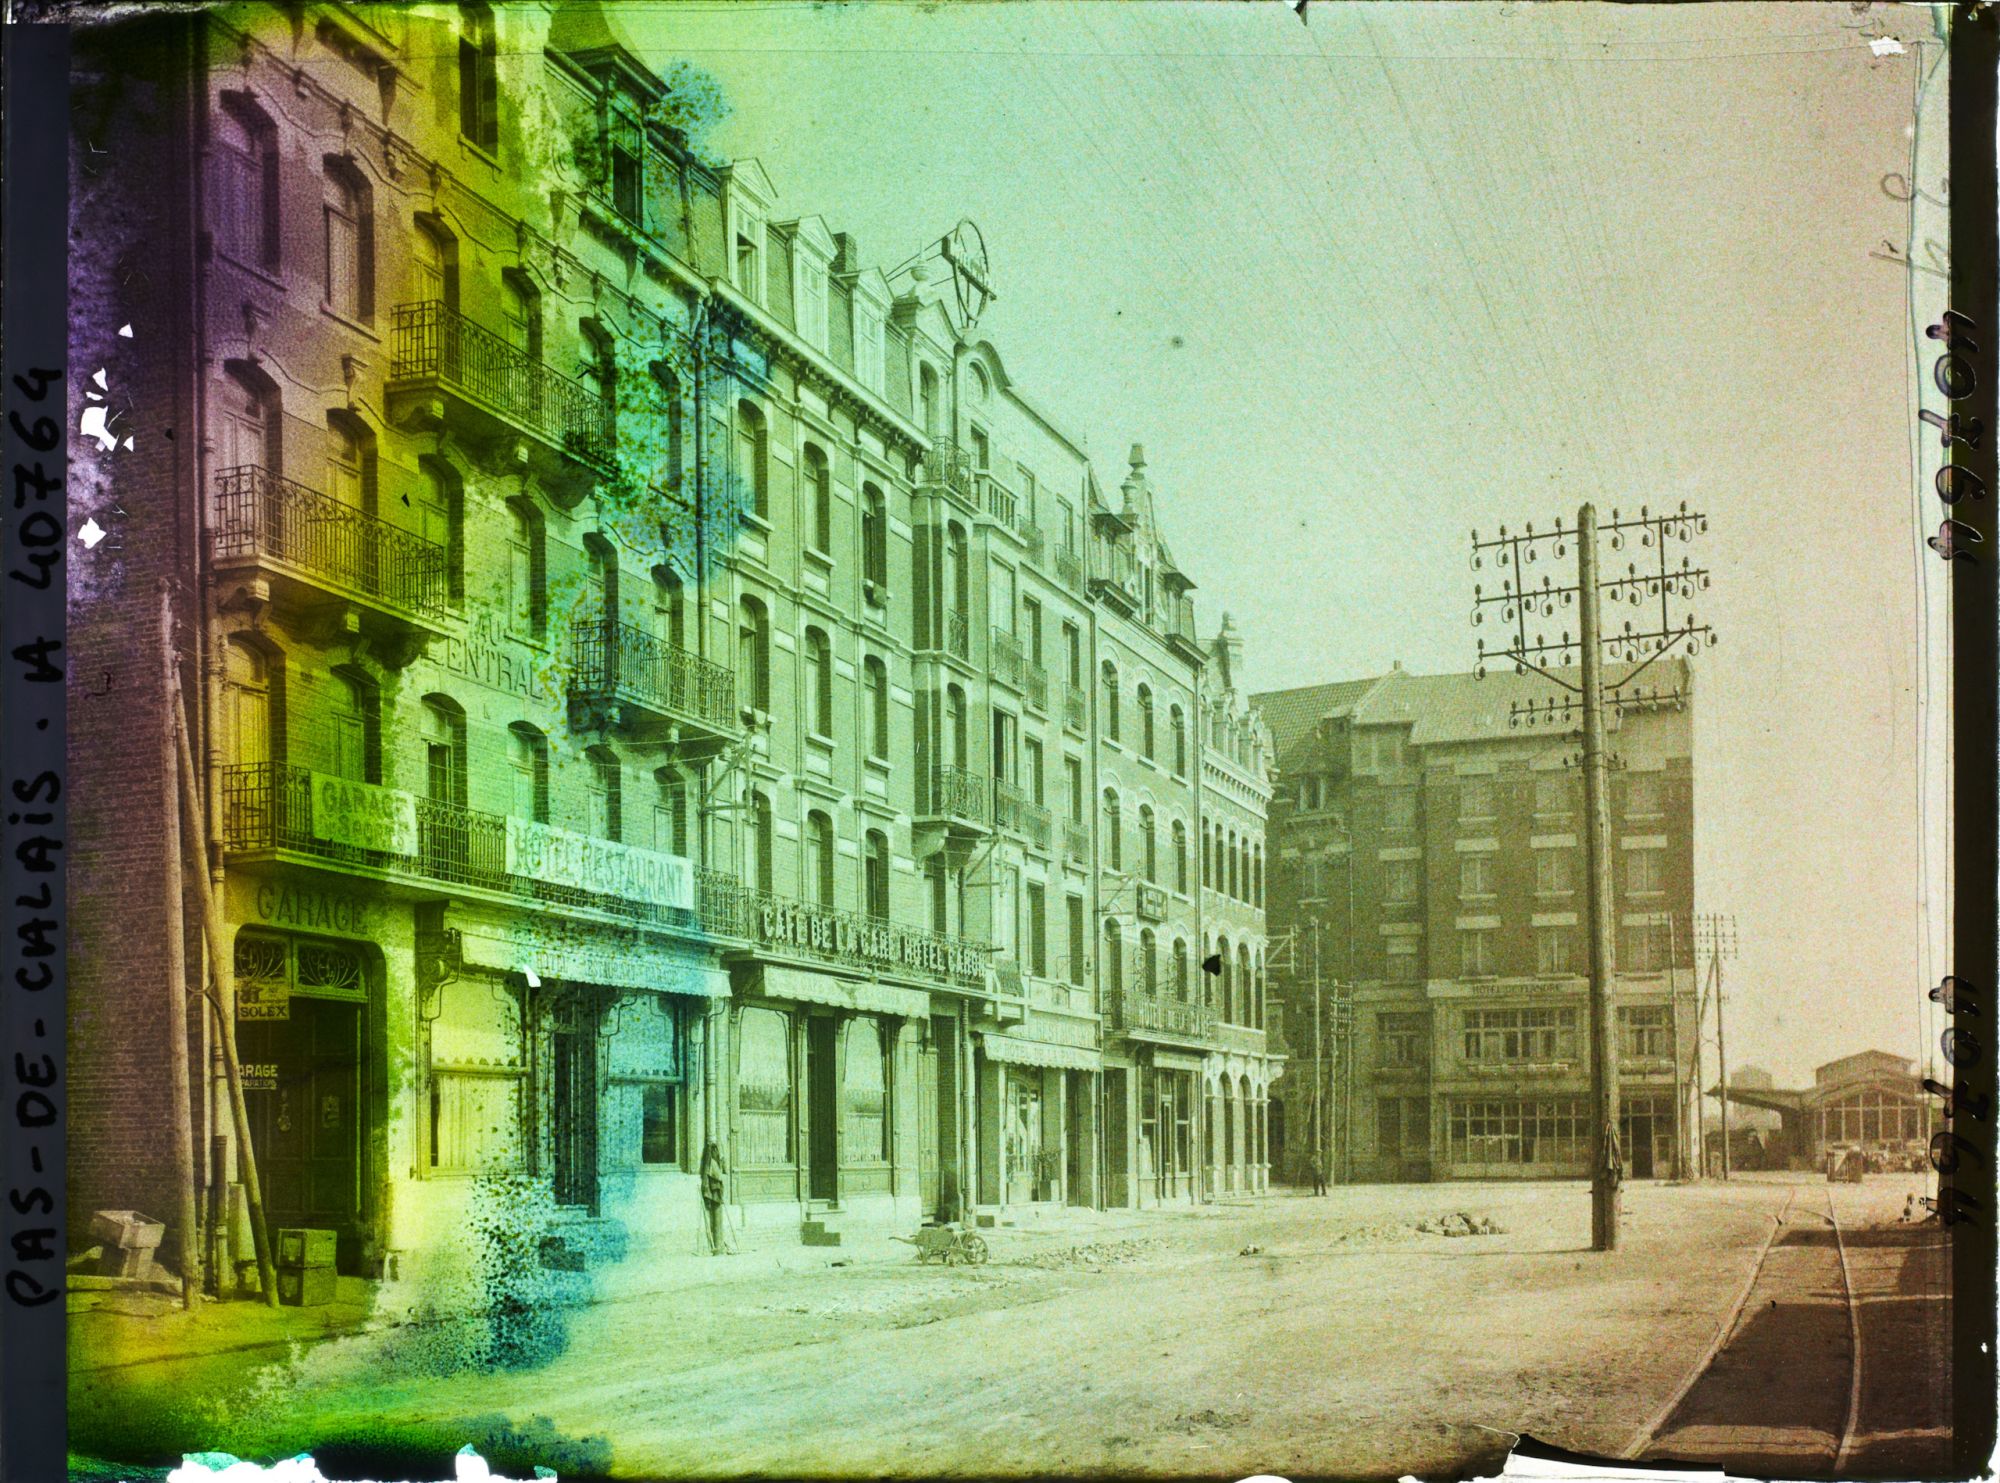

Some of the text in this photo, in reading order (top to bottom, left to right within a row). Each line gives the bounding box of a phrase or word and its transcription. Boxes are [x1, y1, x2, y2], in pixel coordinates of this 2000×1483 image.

[1918, 309, 1984, 567] 40764
[8, 367, 64, 590] 40764
[11, 636, 64, 683] A
[322, 780, 408, 820] GARAGE
[514, 824, 684, 905] HOTEL RESTAURANT
[257, 884, 368, 935] GARAGE
[811, 914, 833, 949] DE
[836, 919, 858, 953] LA
[904, 933, 946, 971] HOTEL
[240, 1006, 287, 1018] SOLEX
[1472, 984, 1499, 995] HOTEL
[238, 1064, 279, 1078] ARAGE
[1918, 974, 1990, 1226] 40764
